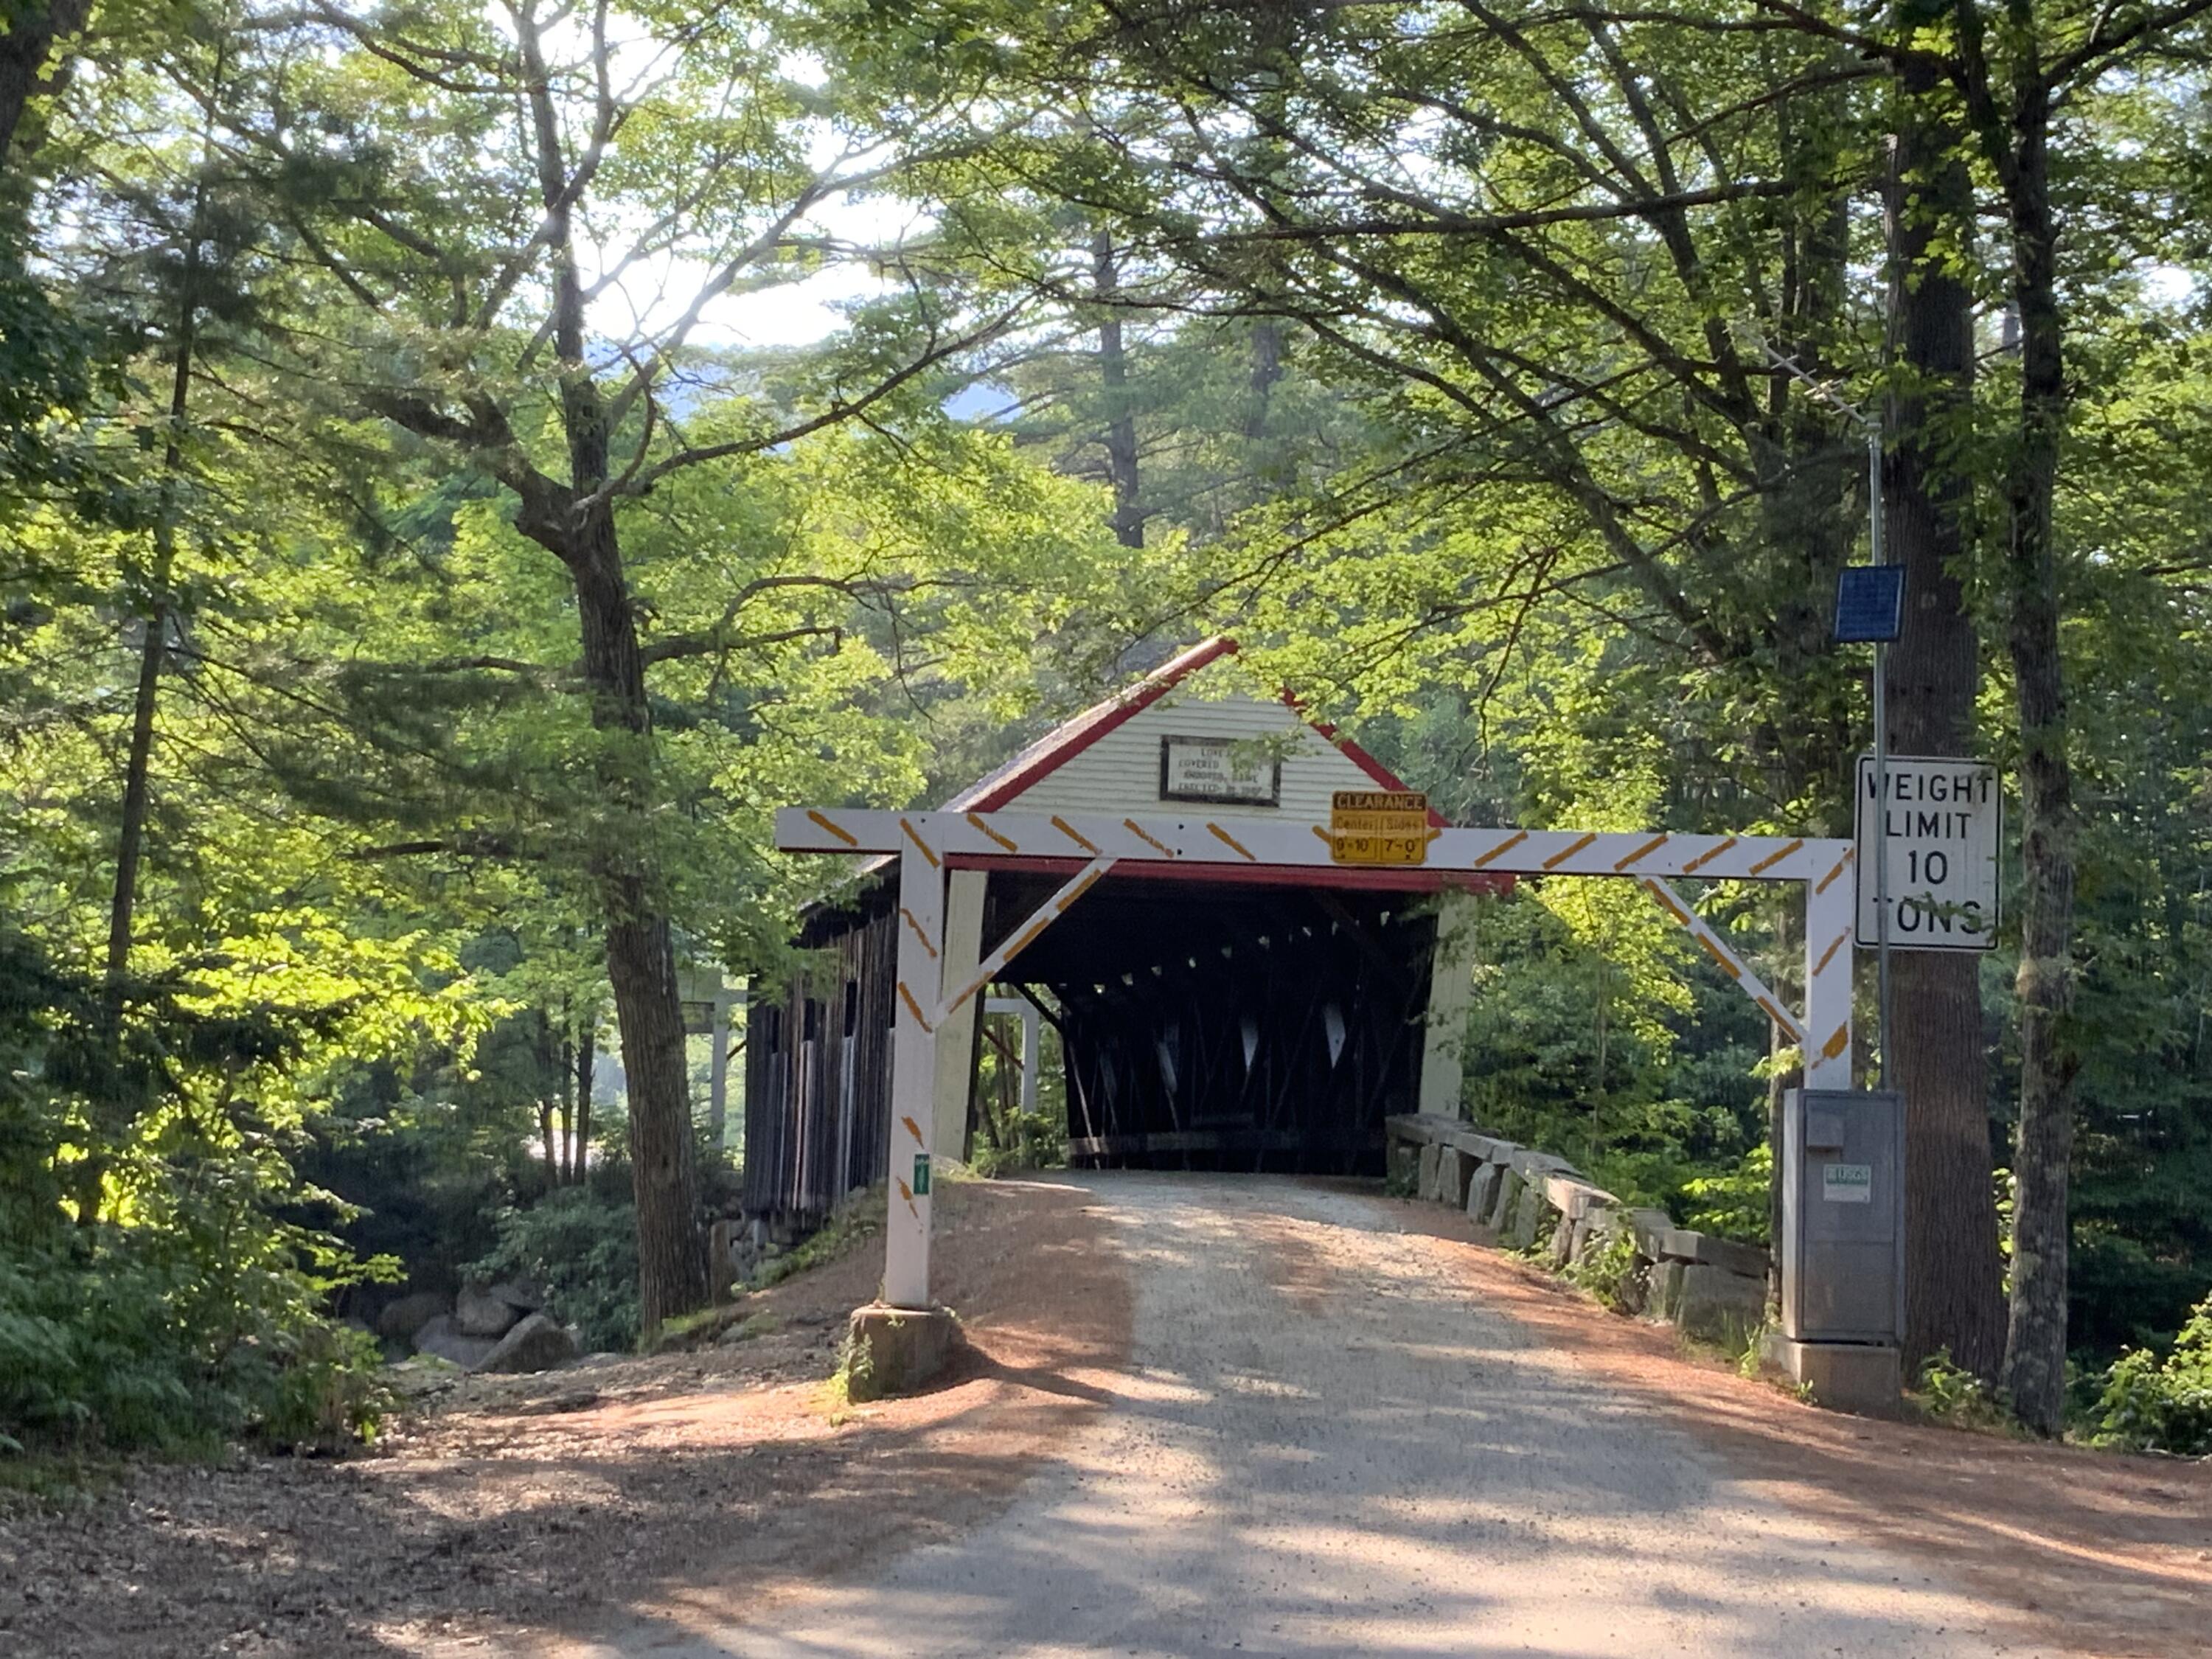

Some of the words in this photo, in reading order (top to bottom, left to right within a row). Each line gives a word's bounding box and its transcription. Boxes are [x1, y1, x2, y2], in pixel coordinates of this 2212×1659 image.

[1868, 772, 1993, 803] WEIGHT
[1338, 794, 1423, 810] CLEARANCE
[1338, 816, 1373, 829] Center
[1386, 816, 1417, 830] Sides
[1885, 810, 1972, 838] LIMIT
[1908, 849, 1948, 884] 10
[1872, 897, 1983, 934] ONS
